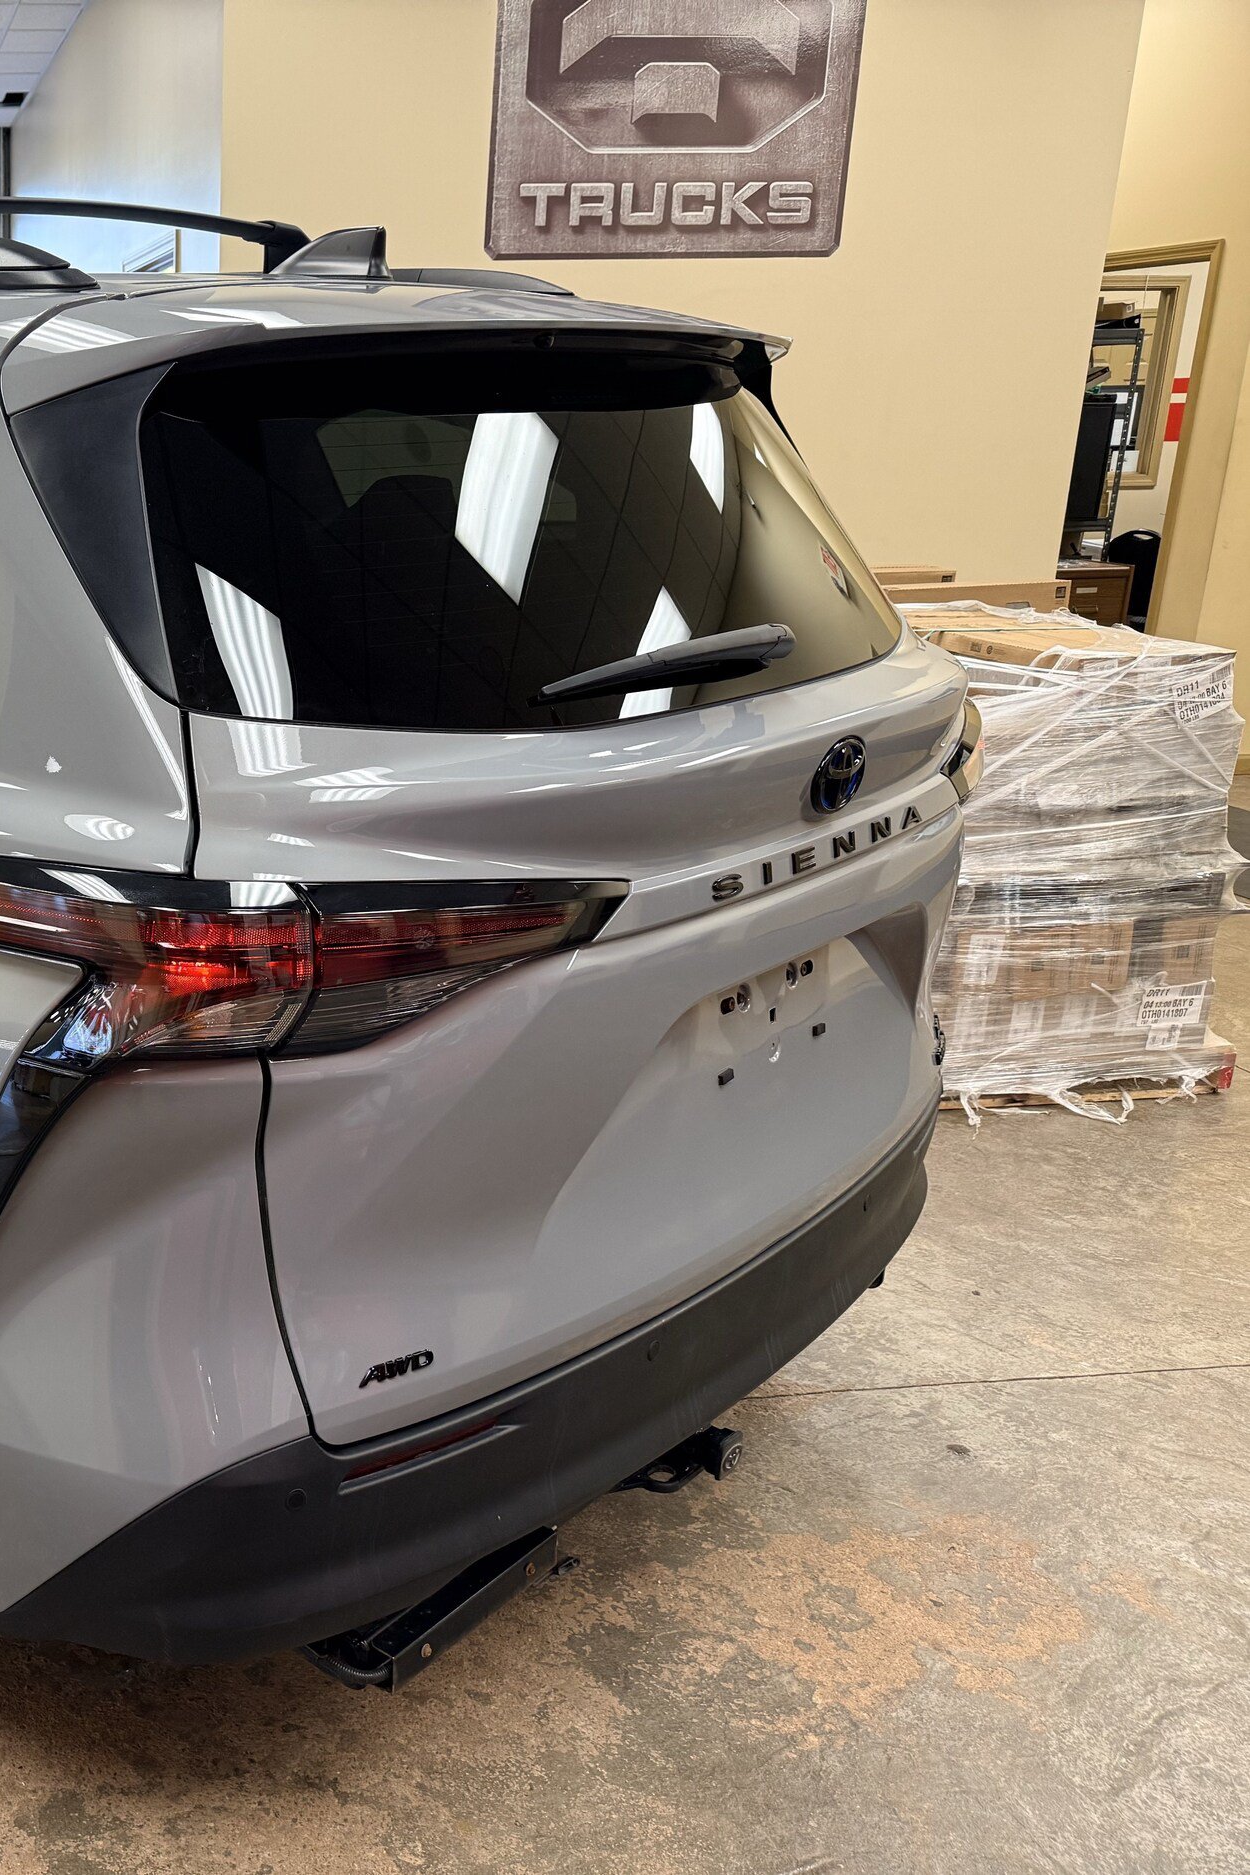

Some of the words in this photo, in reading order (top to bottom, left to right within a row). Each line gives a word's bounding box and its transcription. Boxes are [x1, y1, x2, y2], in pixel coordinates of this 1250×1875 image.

[520, 181, 814, 228] TRUCKS
[1206, 683, 1220, 697] BAY
[1222, 680, 1227, 690] 6
[712, 805, 923, 901] SIENNA
[1146, 987, 1171, 997] DR11
[1172, 998, 1189, 1007] BAY
[1188, 997, 1195, 1007] 6
[358, 1348, 434, 1389] AWD
